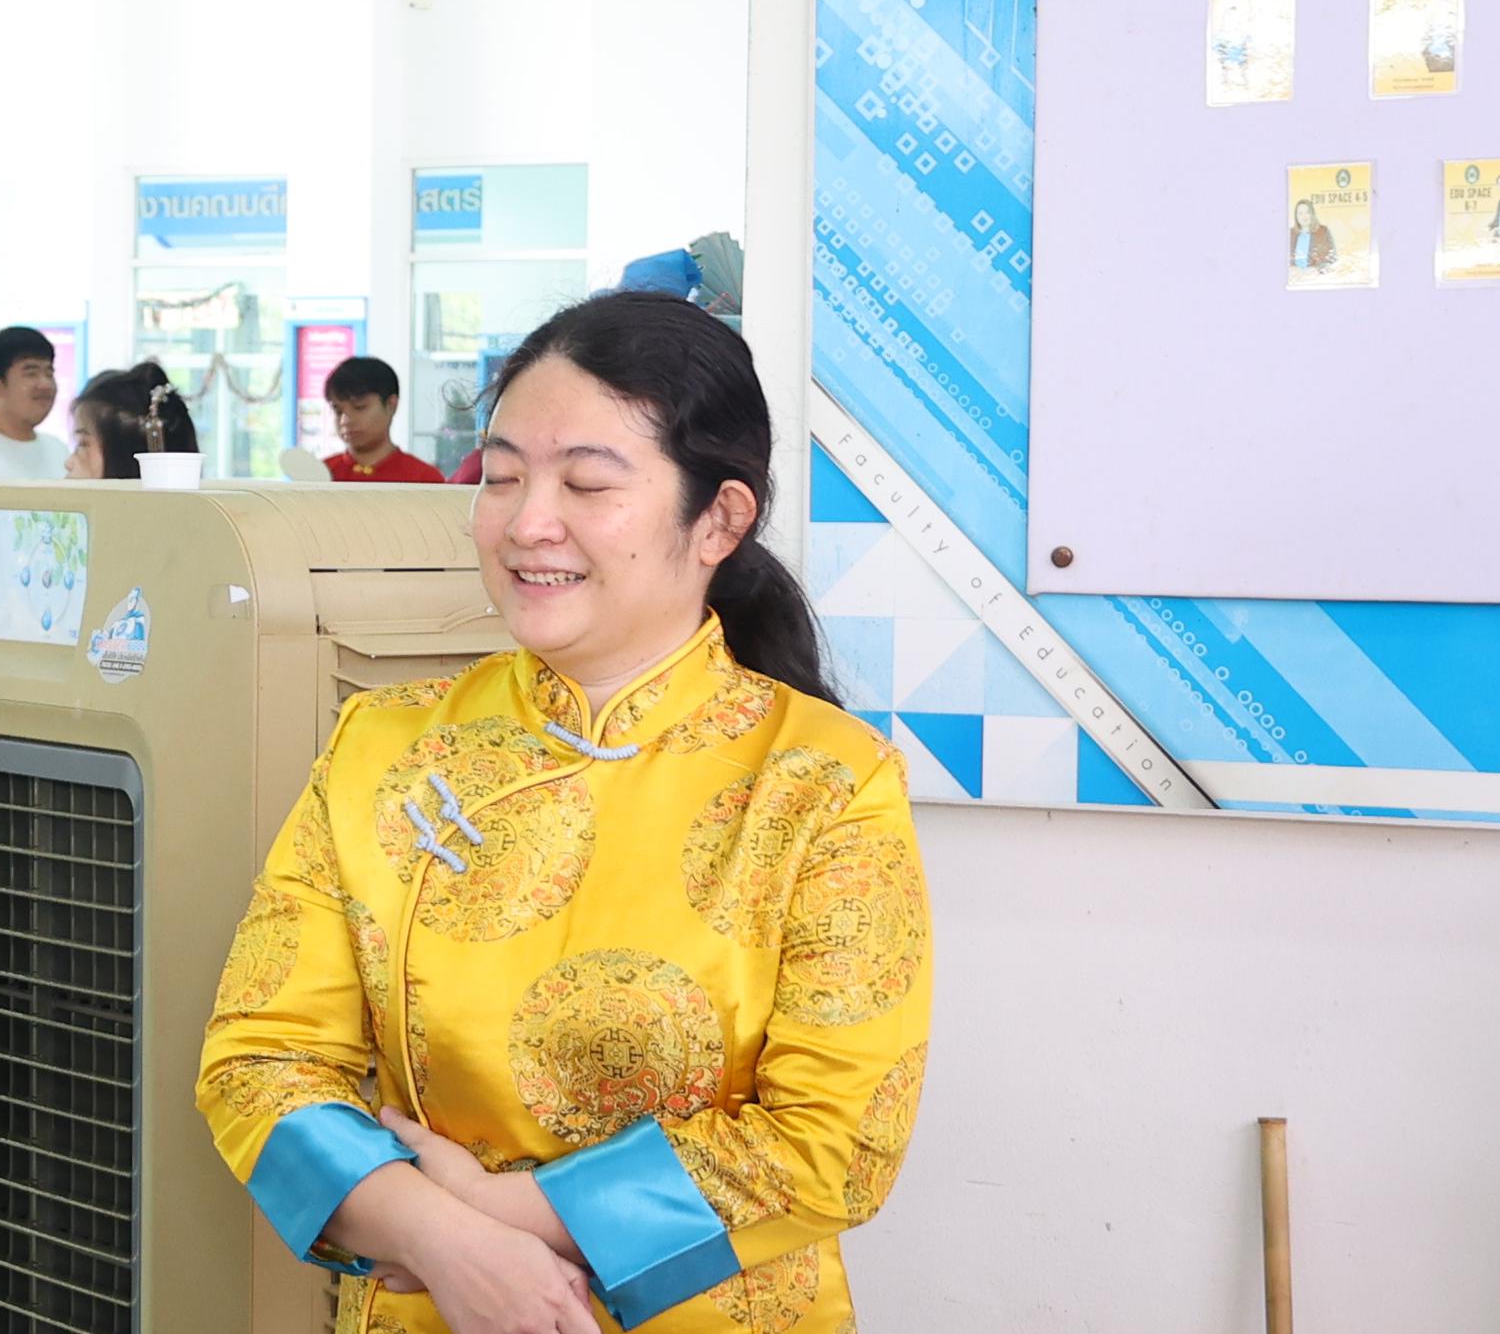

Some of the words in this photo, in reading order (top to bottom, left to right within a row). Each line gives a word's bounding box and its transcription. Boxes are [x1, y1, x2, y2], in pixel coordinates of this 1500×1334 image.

[139, 182, 287, 219] งานคณบดี
[416, 179, 482, 213] สตร์
[1328, 192, 1352, 204] SPACE
[1467, 187, 1492, 199] SPACE
[838, 432, 949, 555] Faculty
[970, 576, 1003, 605] of
[1018, 624, 1174, 792] Education
